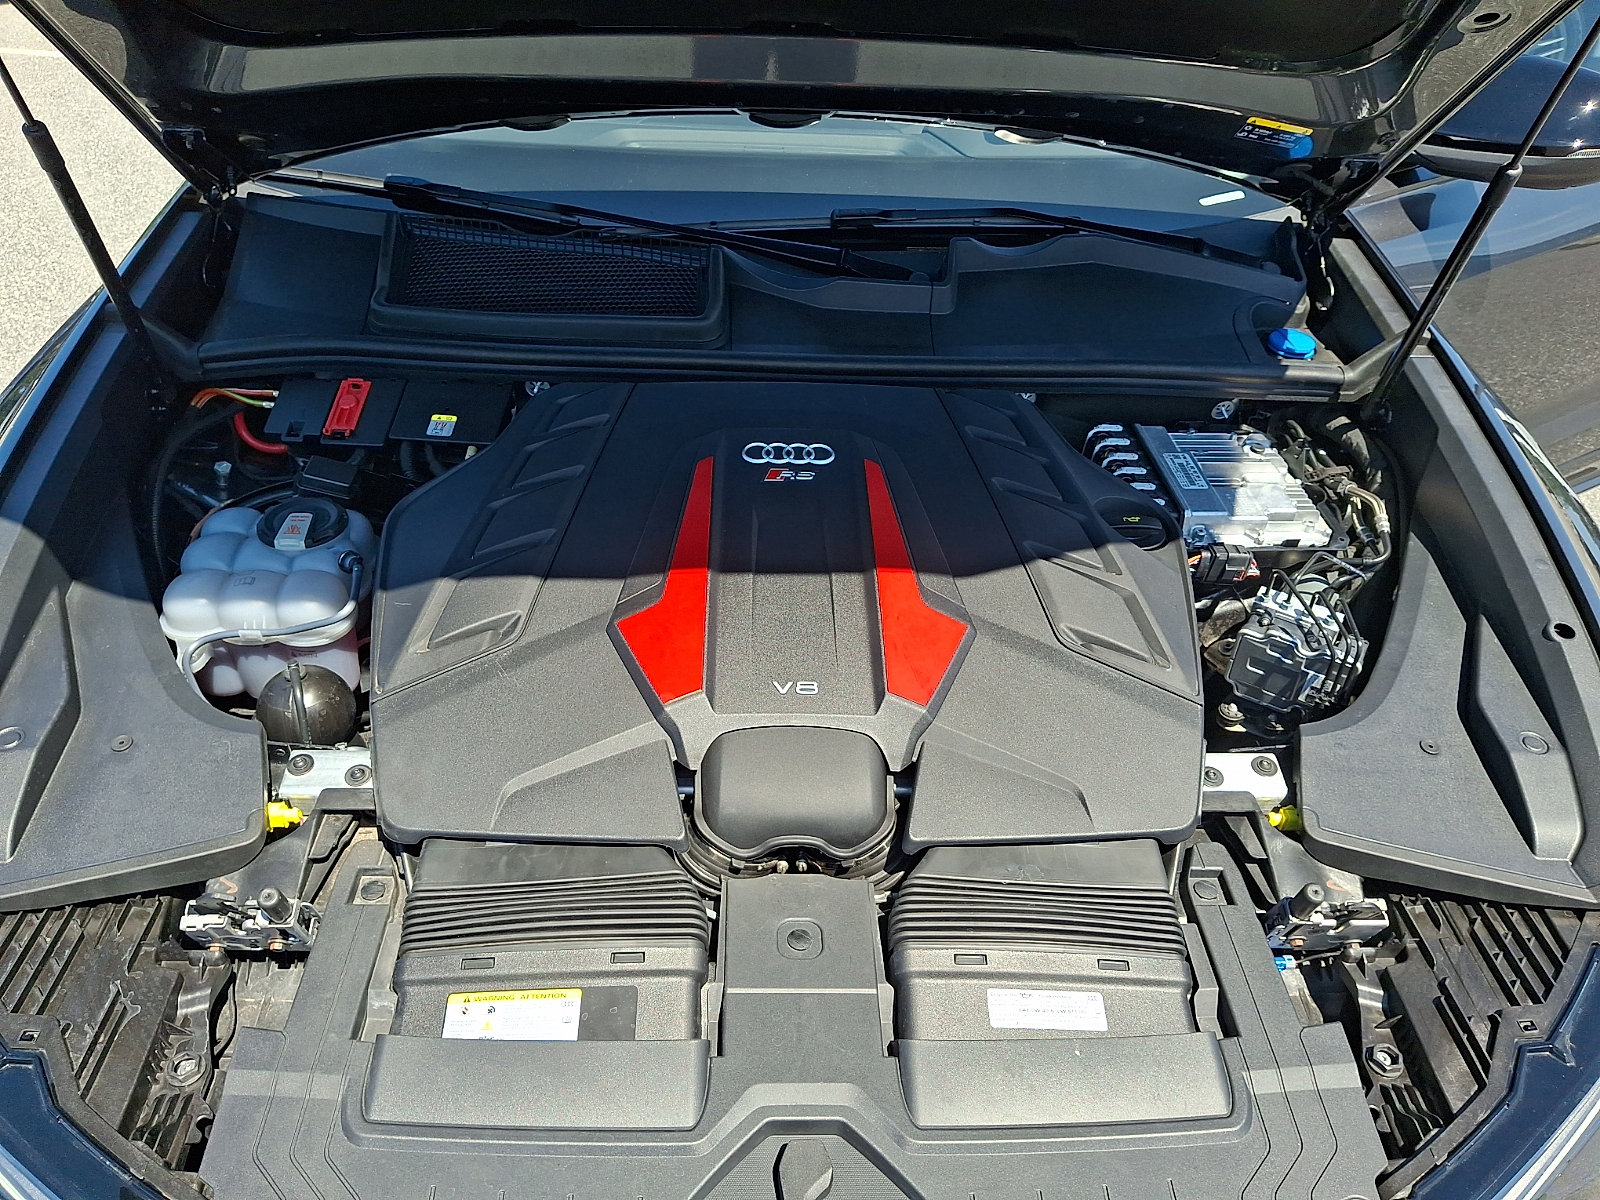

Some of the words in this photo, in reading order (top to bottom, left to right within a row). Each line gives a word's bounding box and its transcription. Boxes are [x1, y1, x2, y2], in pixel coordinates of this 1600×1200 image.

[774, 469, 816, 481] RS
[771, 681, 819, 695] V8
[474, 994, 515, 1002] WARNING
[520, 992, 567, 1000] ATTENTION
